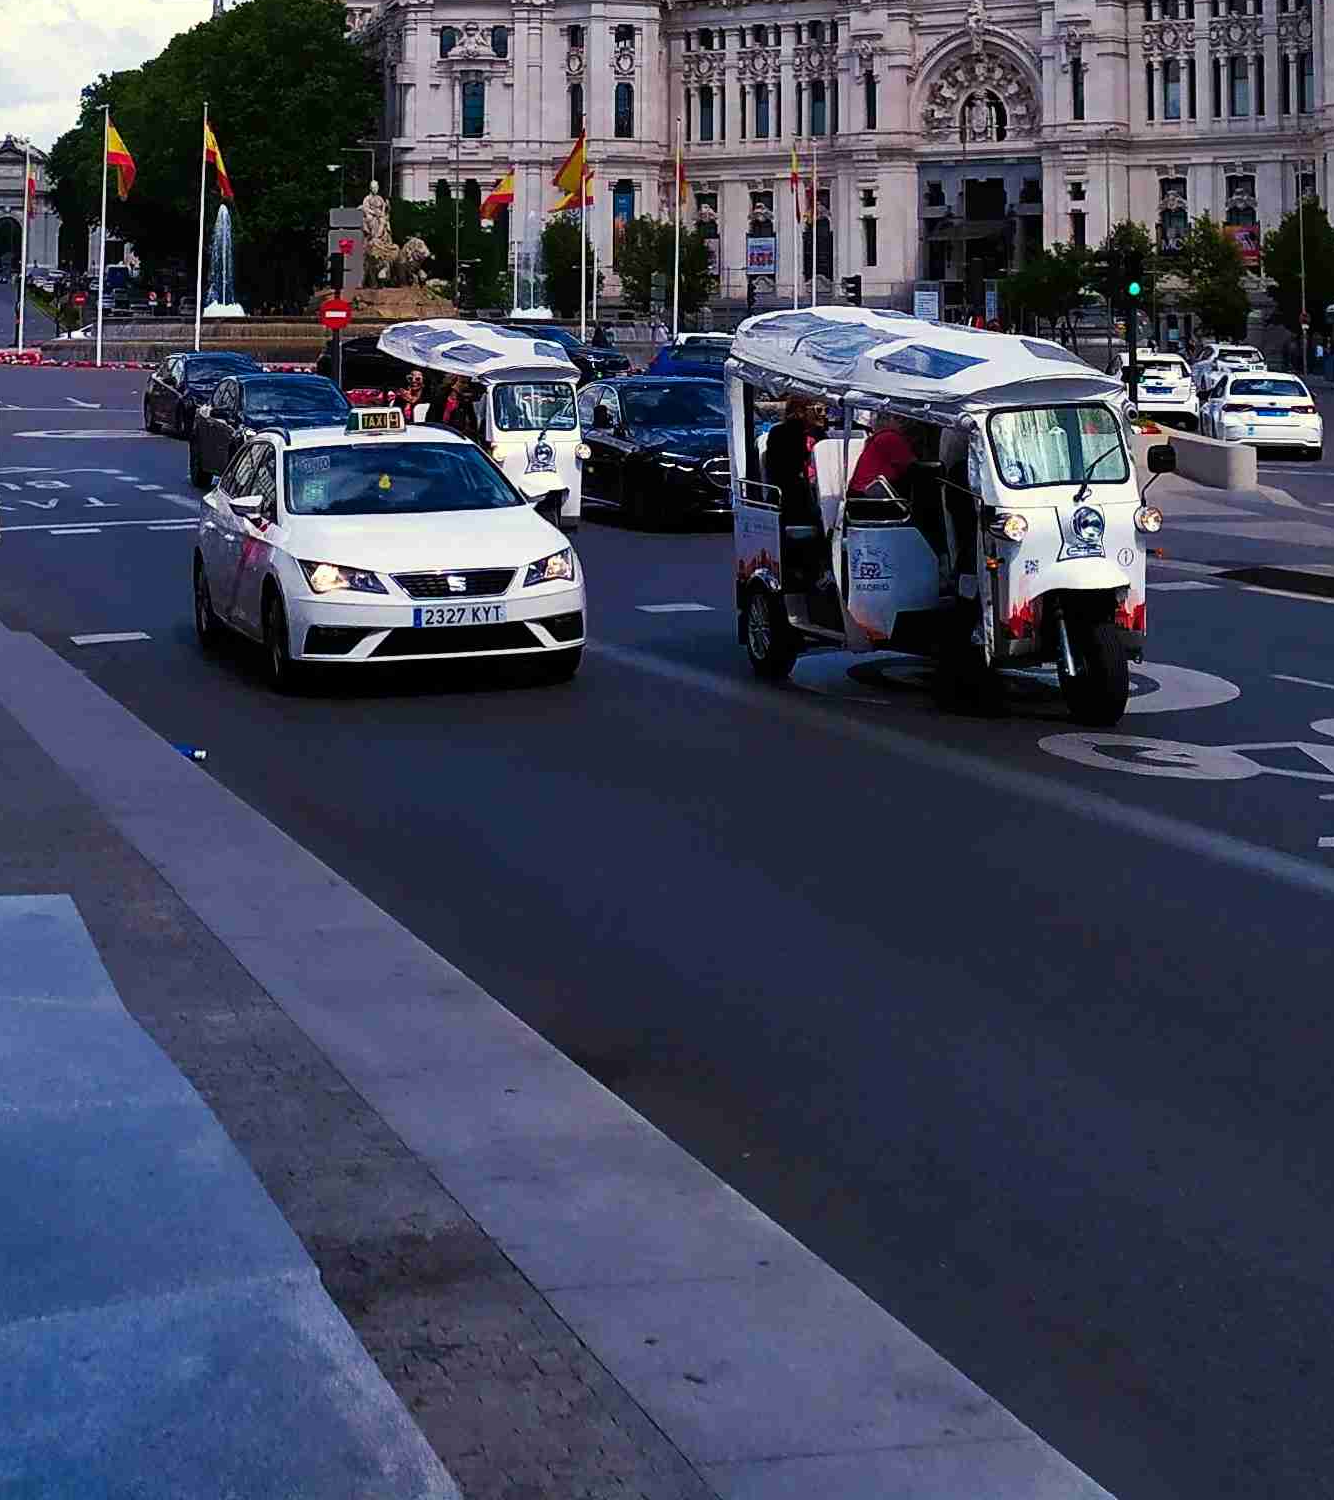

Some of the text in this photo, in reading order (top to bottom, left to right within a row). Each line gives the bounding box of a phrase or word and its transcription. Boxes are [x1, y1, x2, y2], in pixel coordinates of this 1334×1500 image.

[363, 413, 387, 427] TAXI
[425, 605, 502, 626] 2327 KYT
